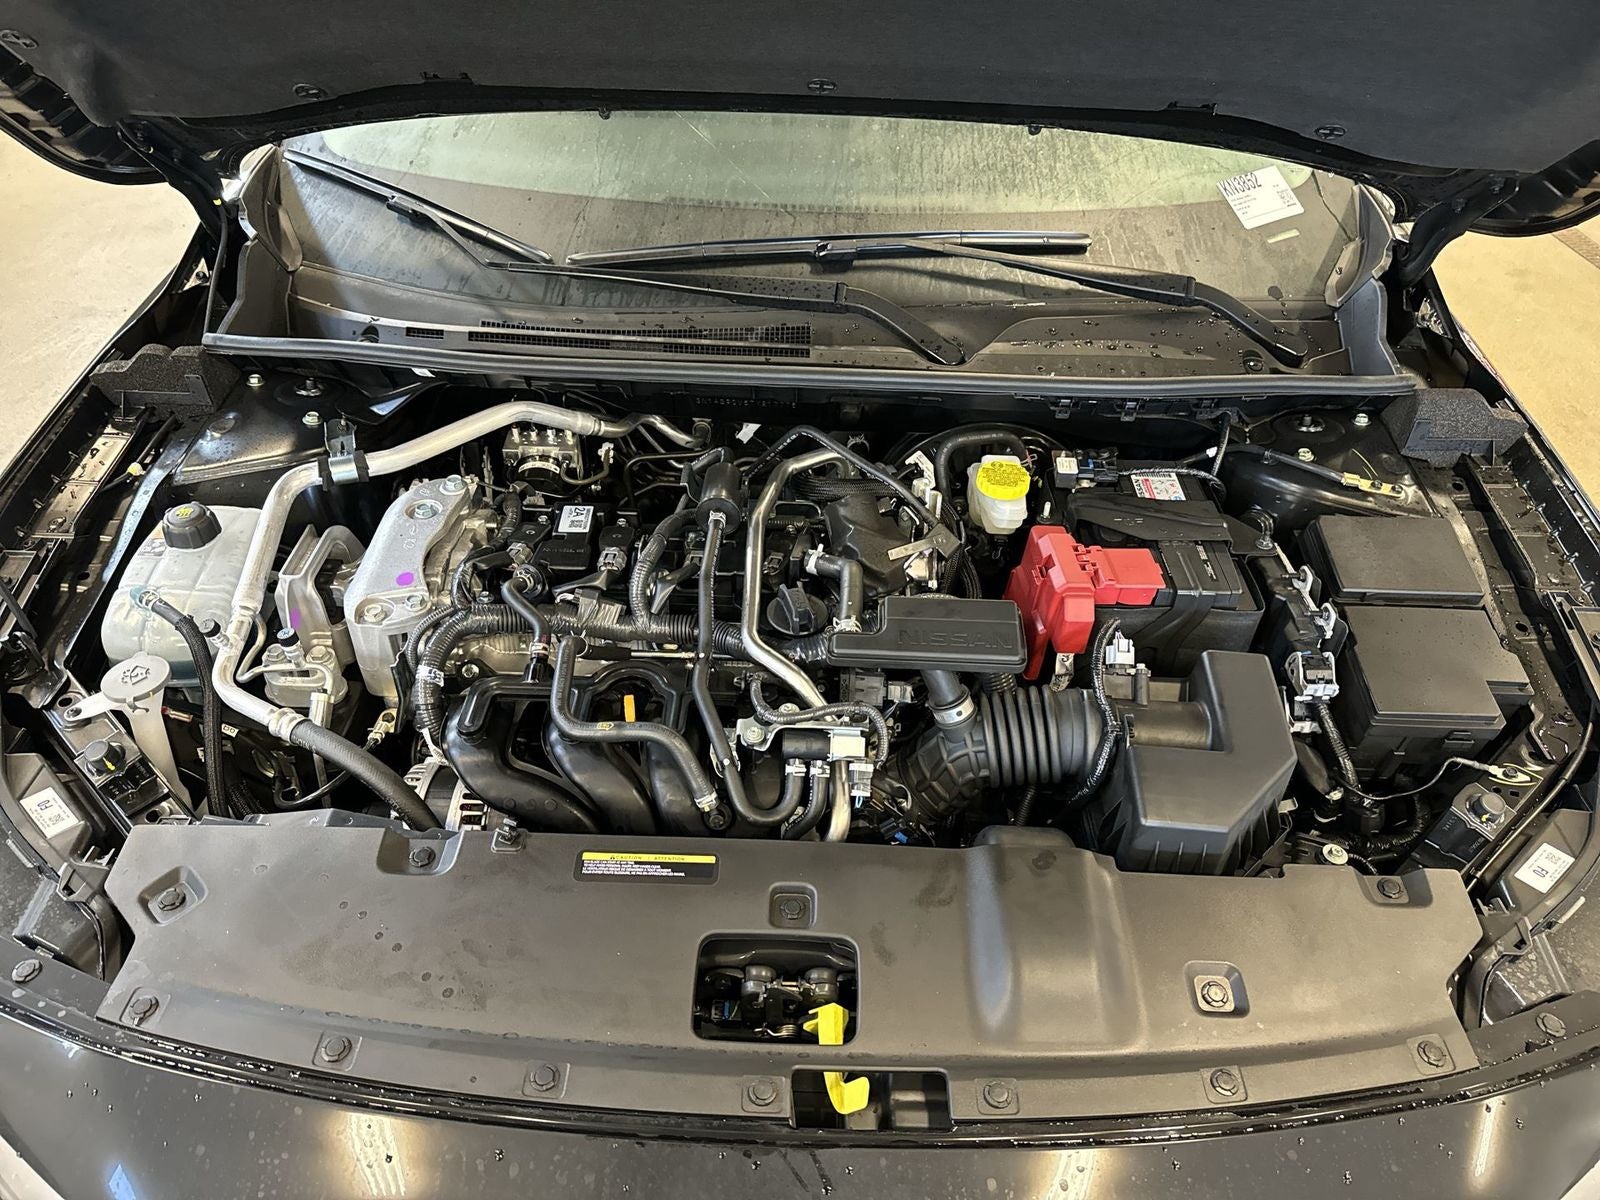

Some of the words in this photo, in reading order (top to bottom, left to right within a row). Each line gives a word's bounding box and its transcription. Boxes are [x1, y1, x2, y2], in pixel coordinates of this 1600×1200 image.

[1220, 172, 1262, 197] KN3852
[573, 507, 586, 517] 2A
[897, 629, 1014, 649] NISSAN
